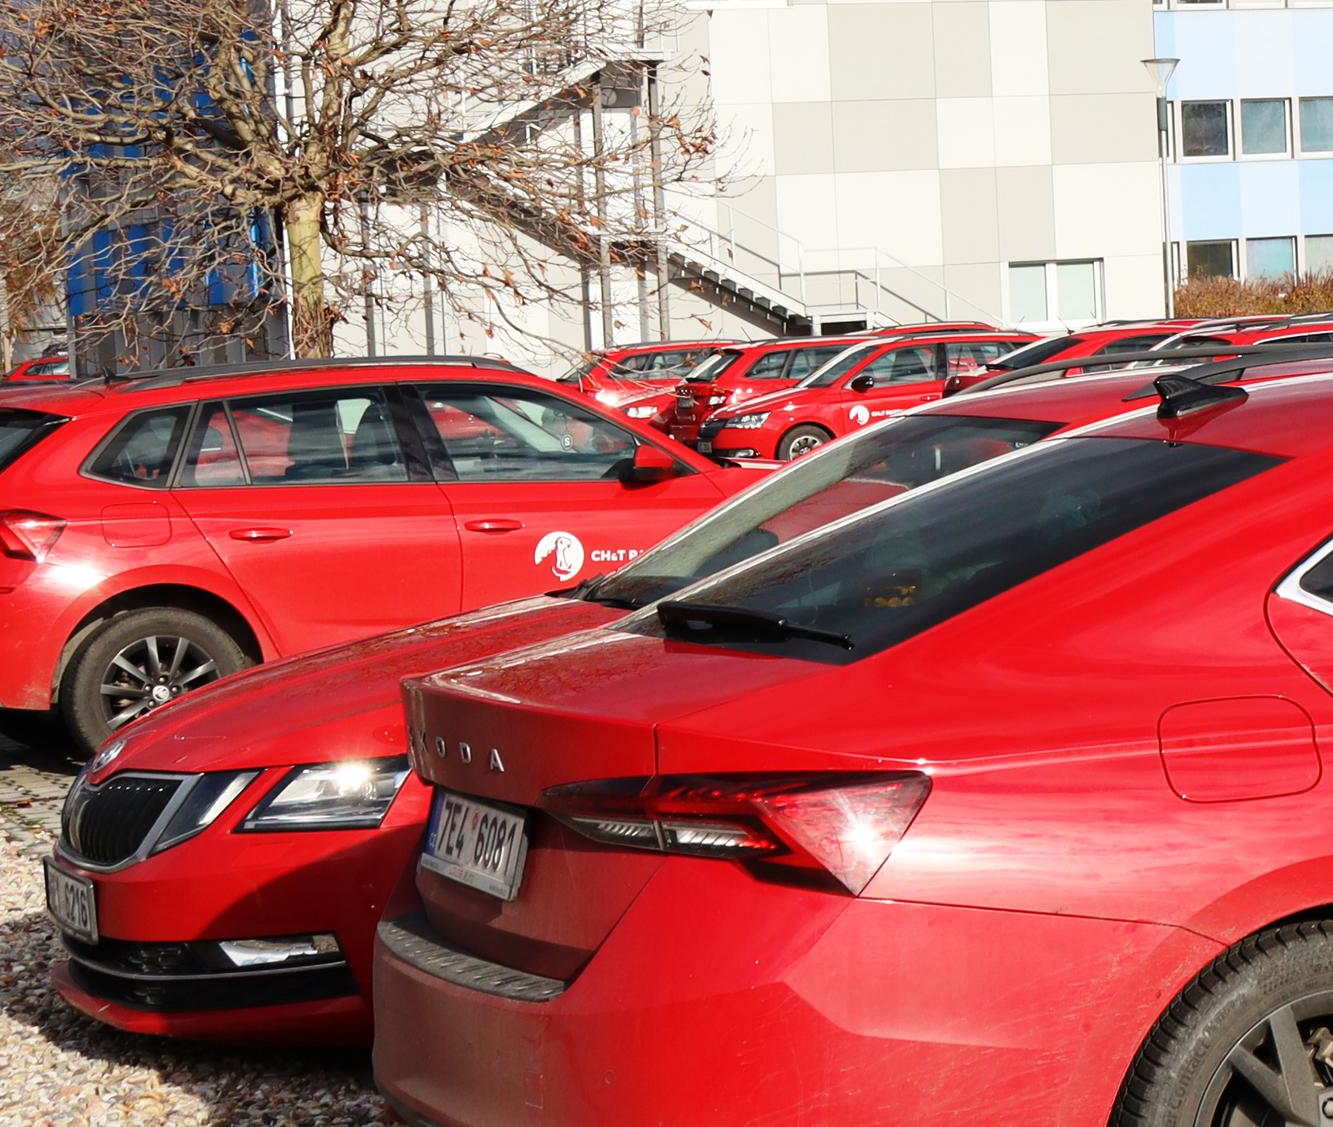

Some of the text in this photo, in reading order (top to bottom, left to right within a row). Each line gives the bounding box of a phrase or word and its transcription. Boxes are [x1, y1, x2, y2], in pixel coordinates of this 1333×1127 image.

[590, 549, 626, 562] CH&T
[437, 800, 469, 860] 7E4
[474, 813, 517, 878] 6081
